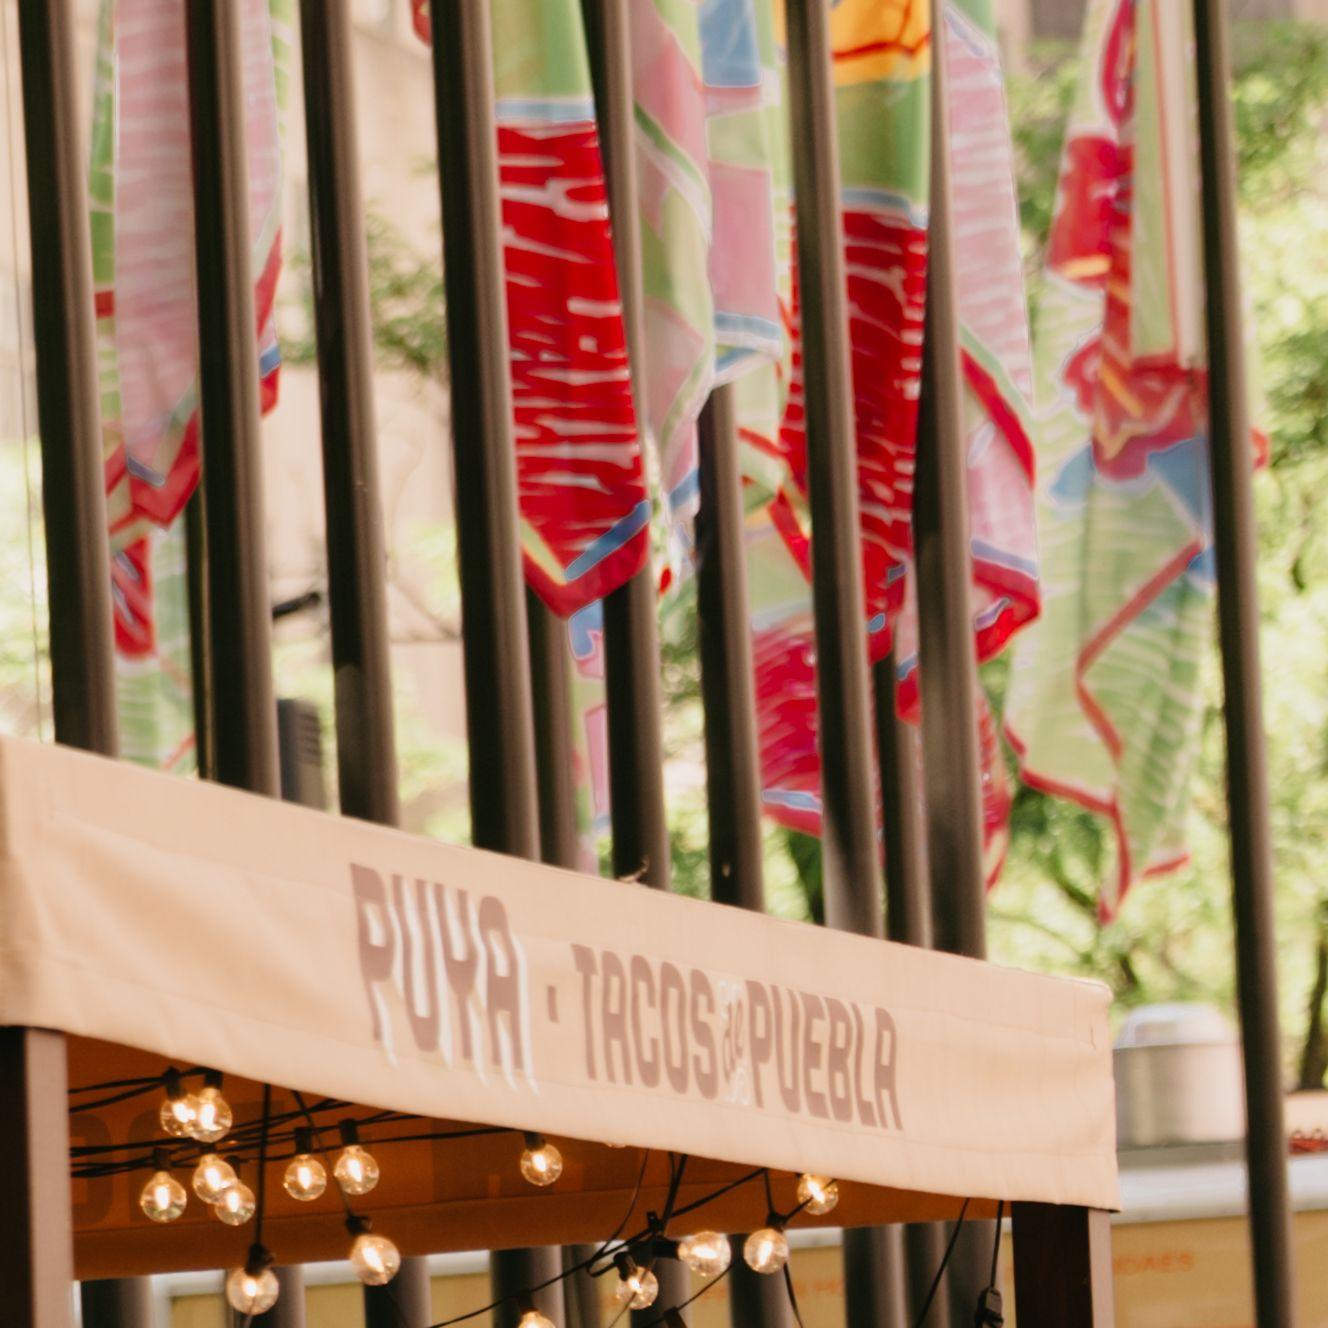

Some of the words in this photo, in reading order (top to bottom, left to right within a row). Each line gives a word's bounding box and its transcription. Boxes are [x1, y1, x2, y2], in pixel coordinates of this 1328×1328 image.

[349, 862, 530, 1072] PUYA
[572, 942, 720, 1102] TACOS
[747, 982, 904, 1133] PUEBLA
